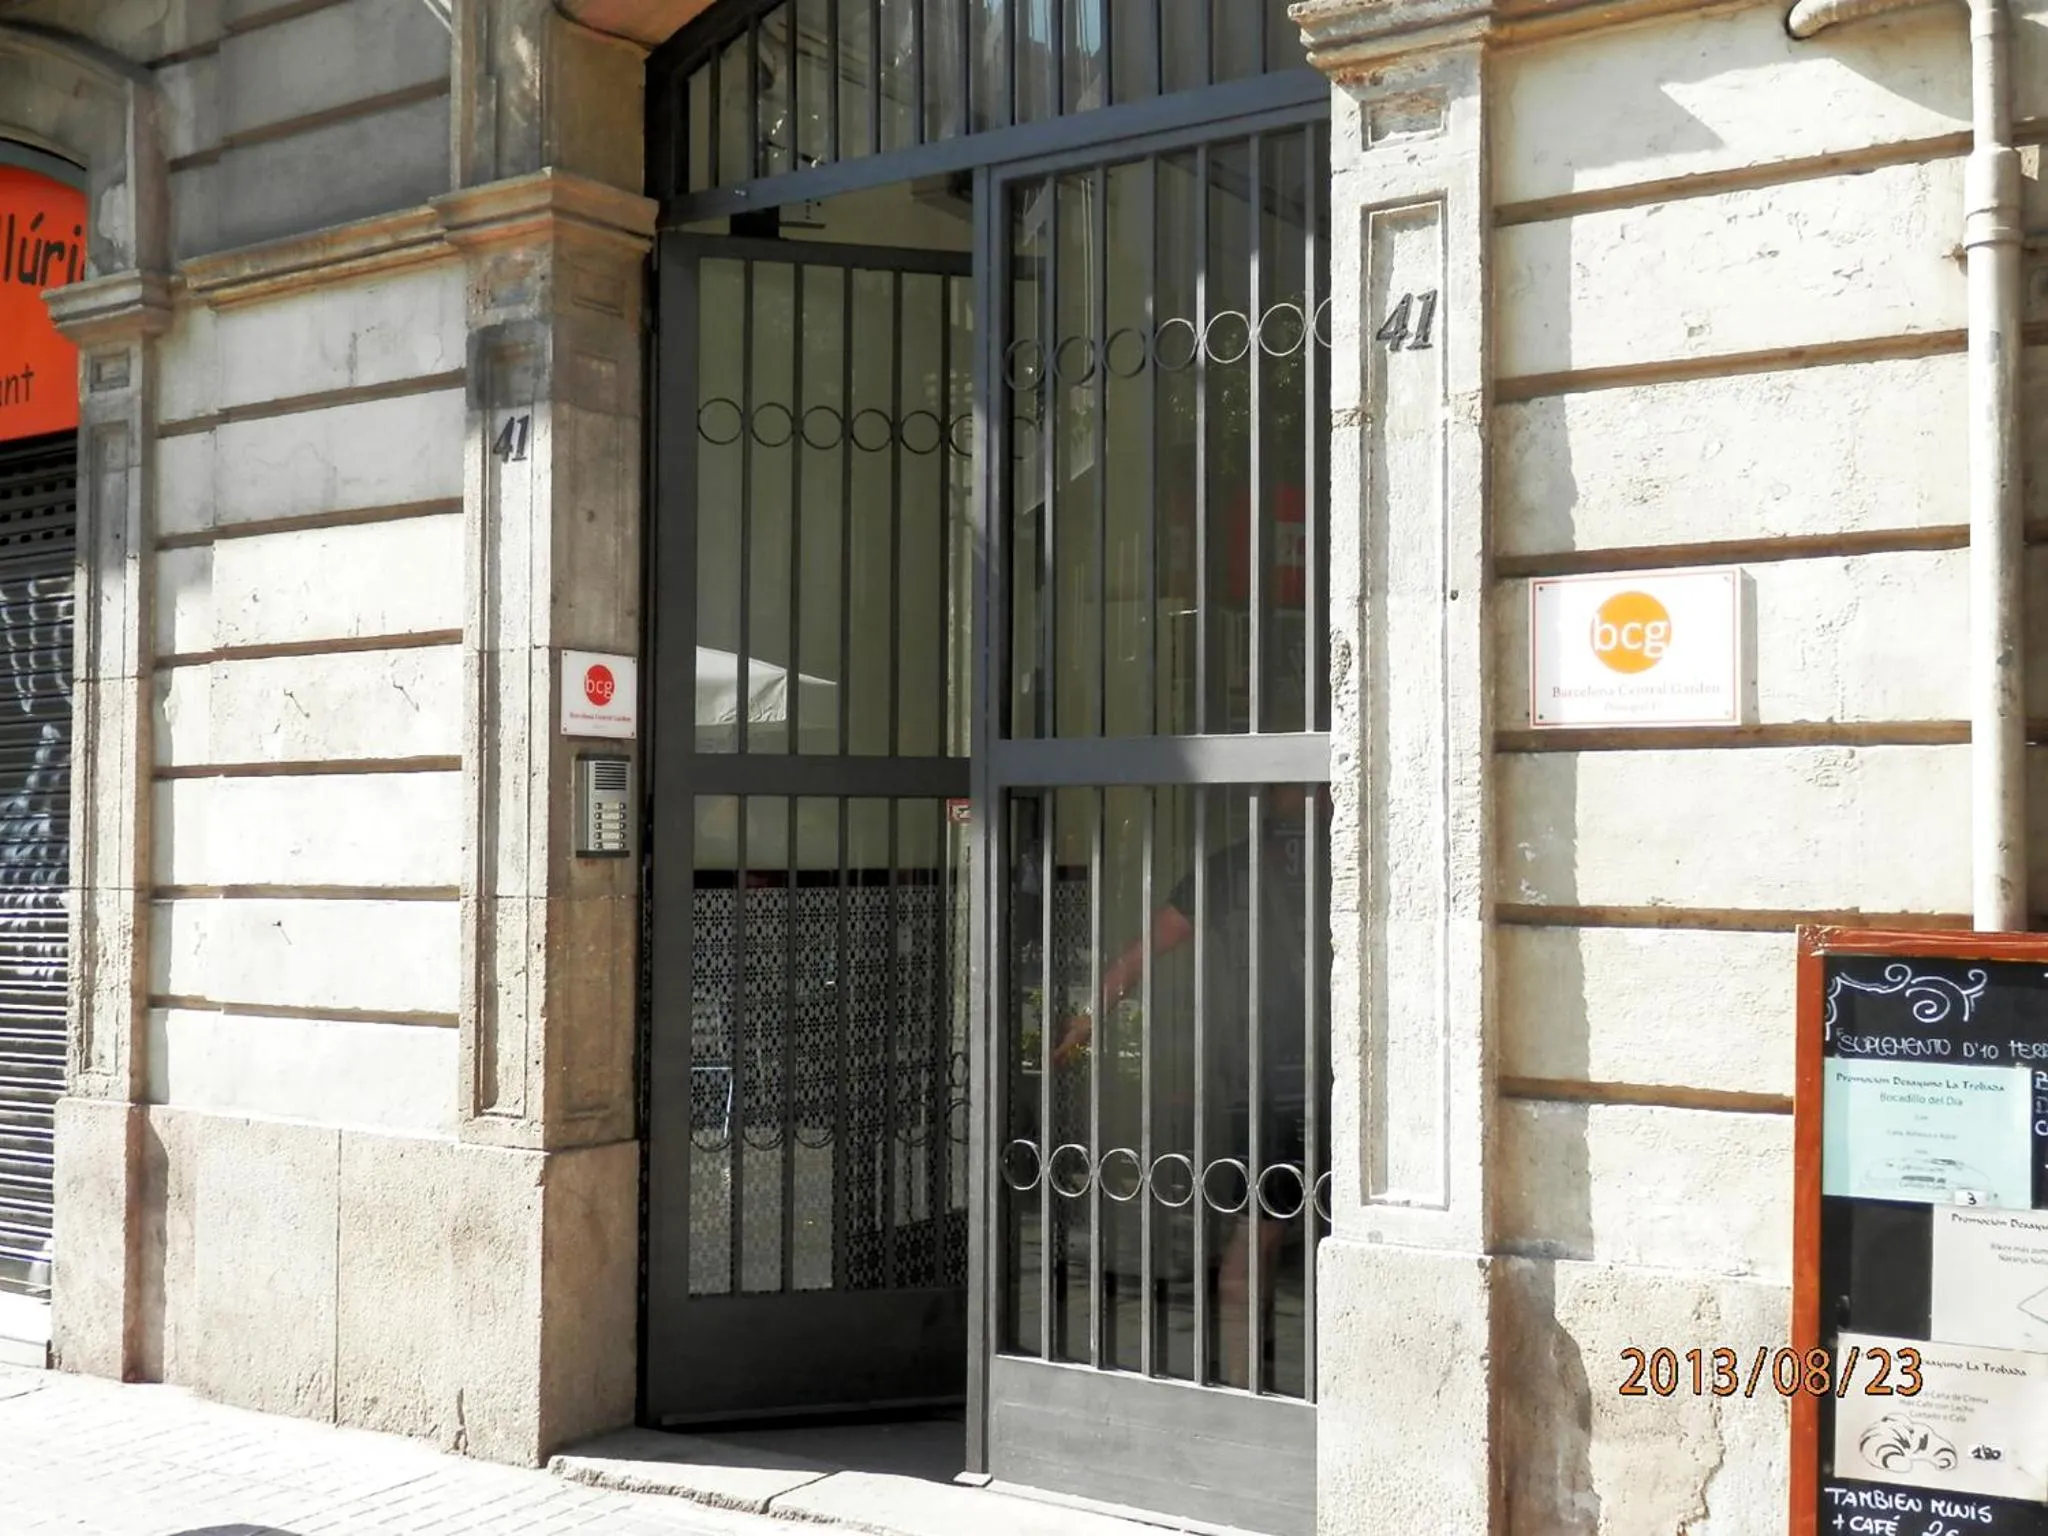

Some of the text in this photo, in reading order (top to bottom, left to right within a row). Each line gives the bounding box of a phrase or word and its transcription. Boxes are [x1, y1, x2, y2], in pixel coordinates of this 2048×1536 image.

[0, 212, 85, 287] lúri
[1376, 289, 1438, 352] 41
[493, 414, 529, 464] 41
[1593, 611, 1669, 660] bcg
[585, 673, 614, 700] bcg
[1880, 1091, 1926, 1104] Bocadillo
[1824, 1487, 1922, 1512] TAMBIEN
